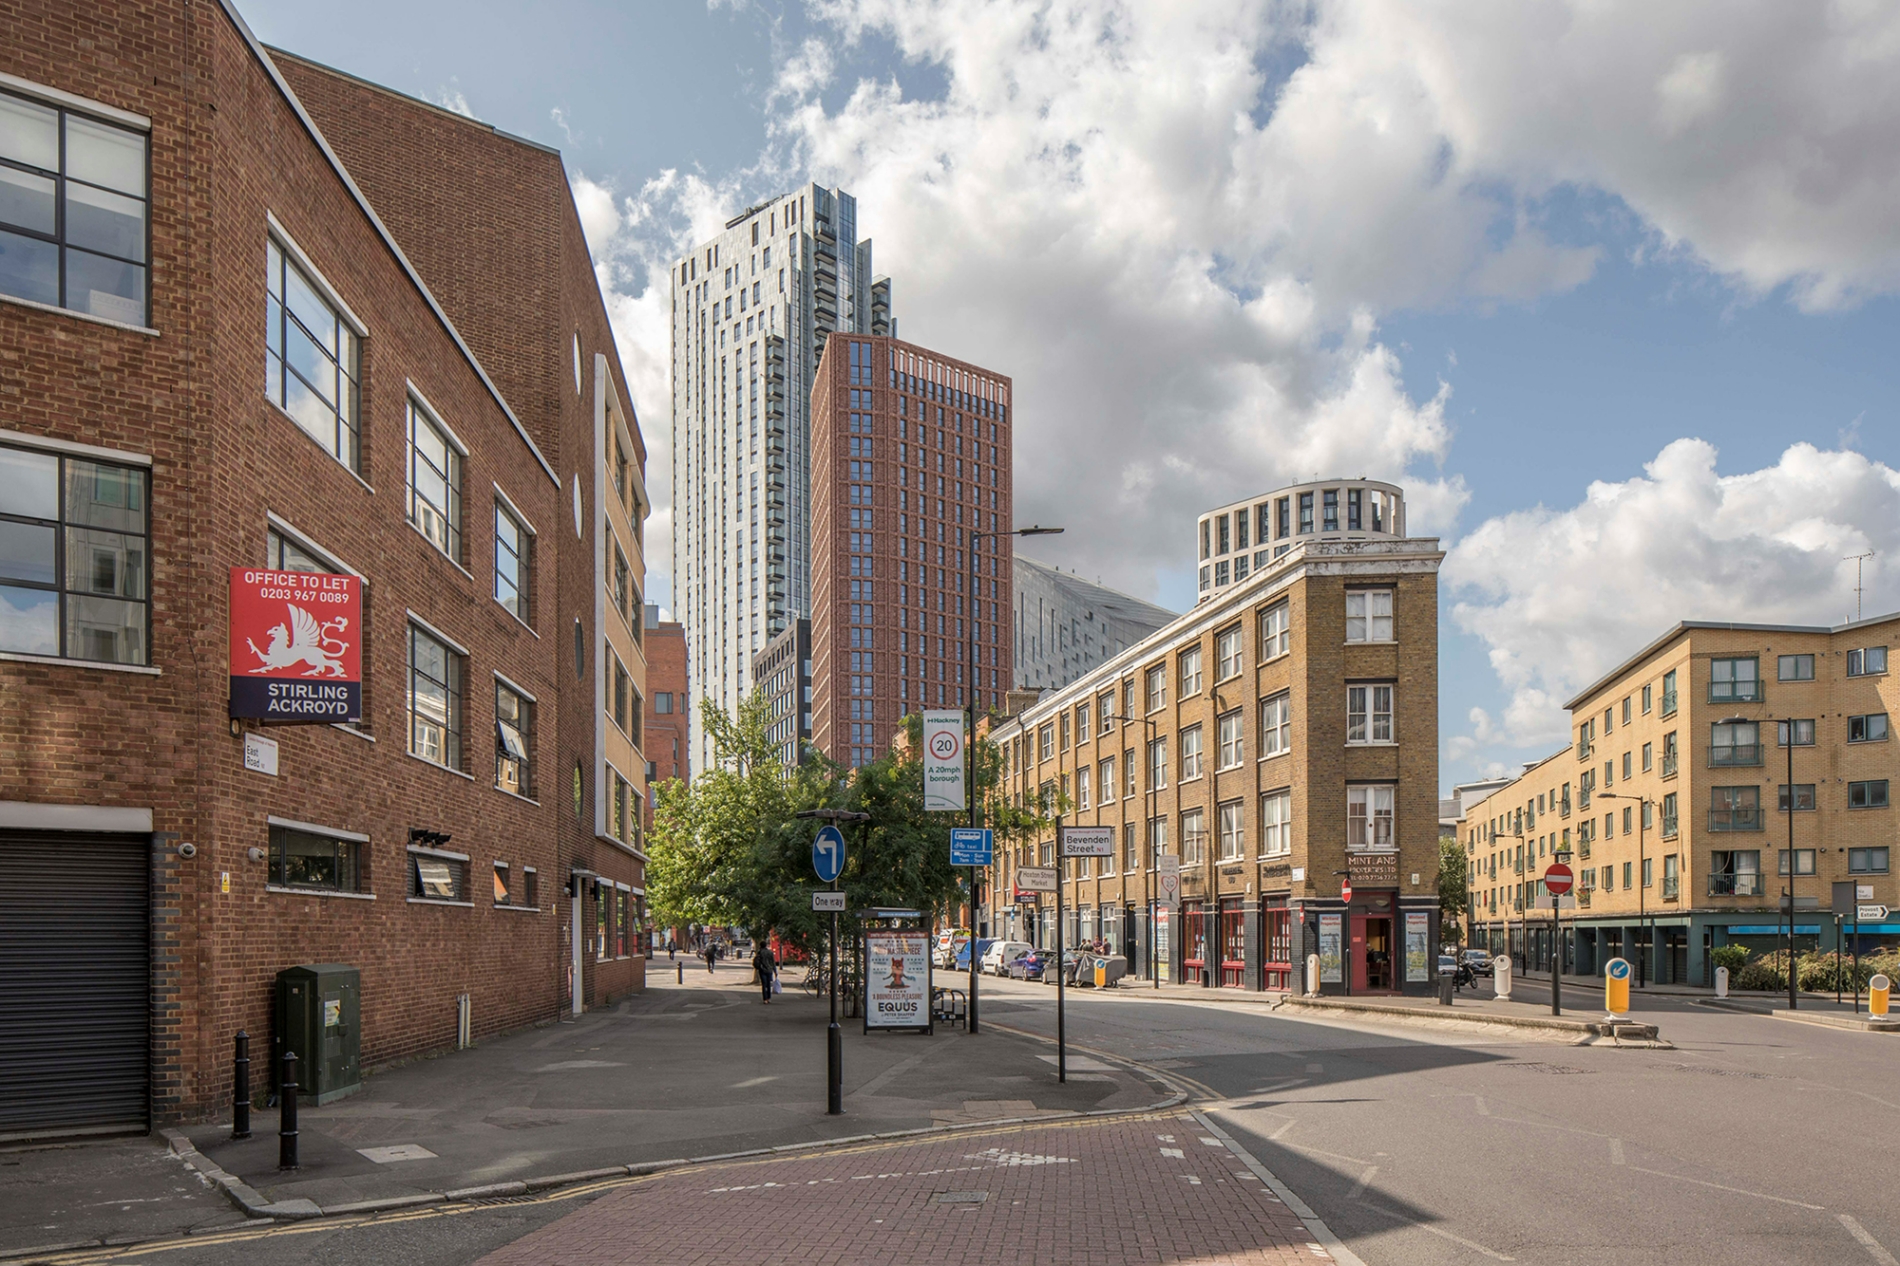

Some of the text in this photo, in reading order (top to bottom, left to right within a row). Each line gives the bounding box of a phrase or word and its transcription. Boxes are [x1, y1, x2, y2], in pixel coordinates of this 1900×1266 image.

[244, 571, 350, 590] OFFICE TO LET
[260, 587, 349, 604] 0203 967 0089
[268, 683, 348, 700] STIRLING
[267, 698, 348, 715] ACKROYD
[936, 740, 953, 752] 20
[935, 766, 961, 775] 20mph
[929, 775, 960, 783] borough
[1066, 836, 1109, 844] Bevenden
[1067, 844, 1094, 852] Street
[815, 896, 843, 907] One way
[878, 1002, 918, 1012] EQUUS
